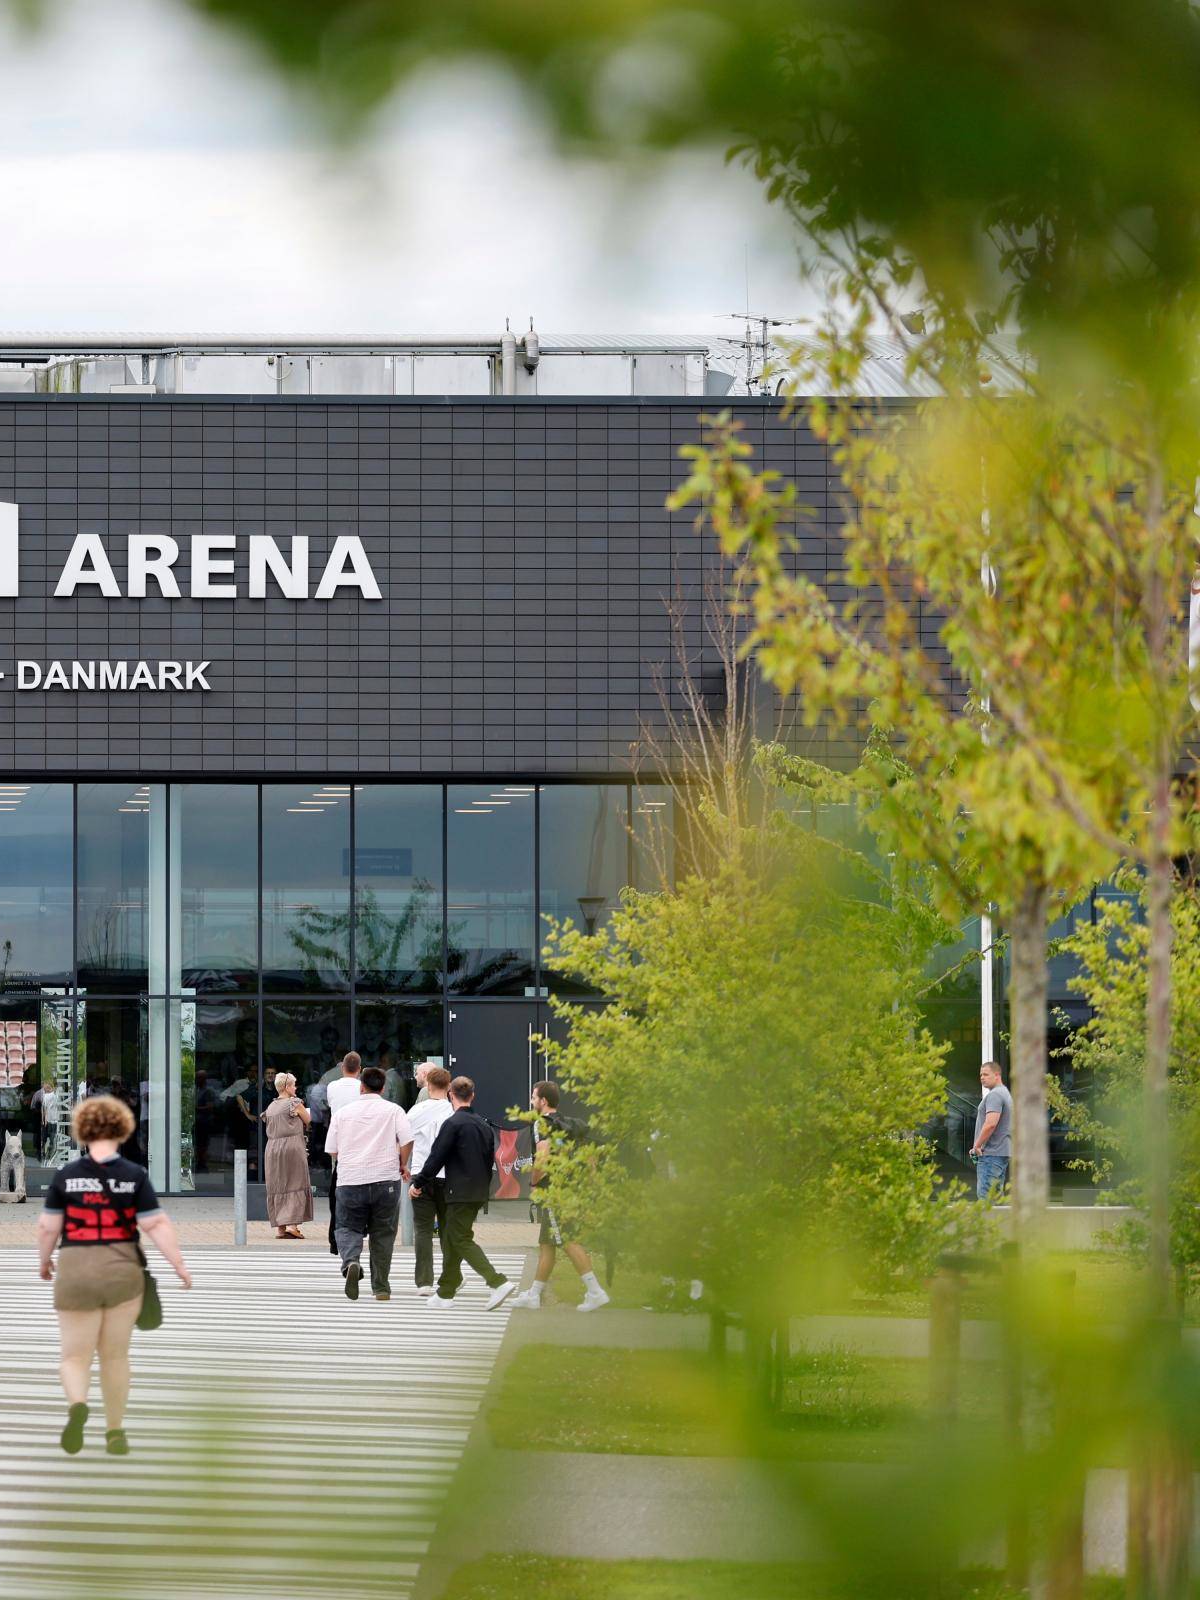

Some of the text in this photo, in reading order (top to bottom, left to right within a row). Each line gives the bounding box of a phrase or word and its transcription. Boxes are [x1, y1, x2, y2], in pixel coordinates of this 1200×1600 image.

[53, 533, 384, 600] ARENA
[16, 660, 213, 691] DANMARK
[56, 1006, 73, 1032] FC
